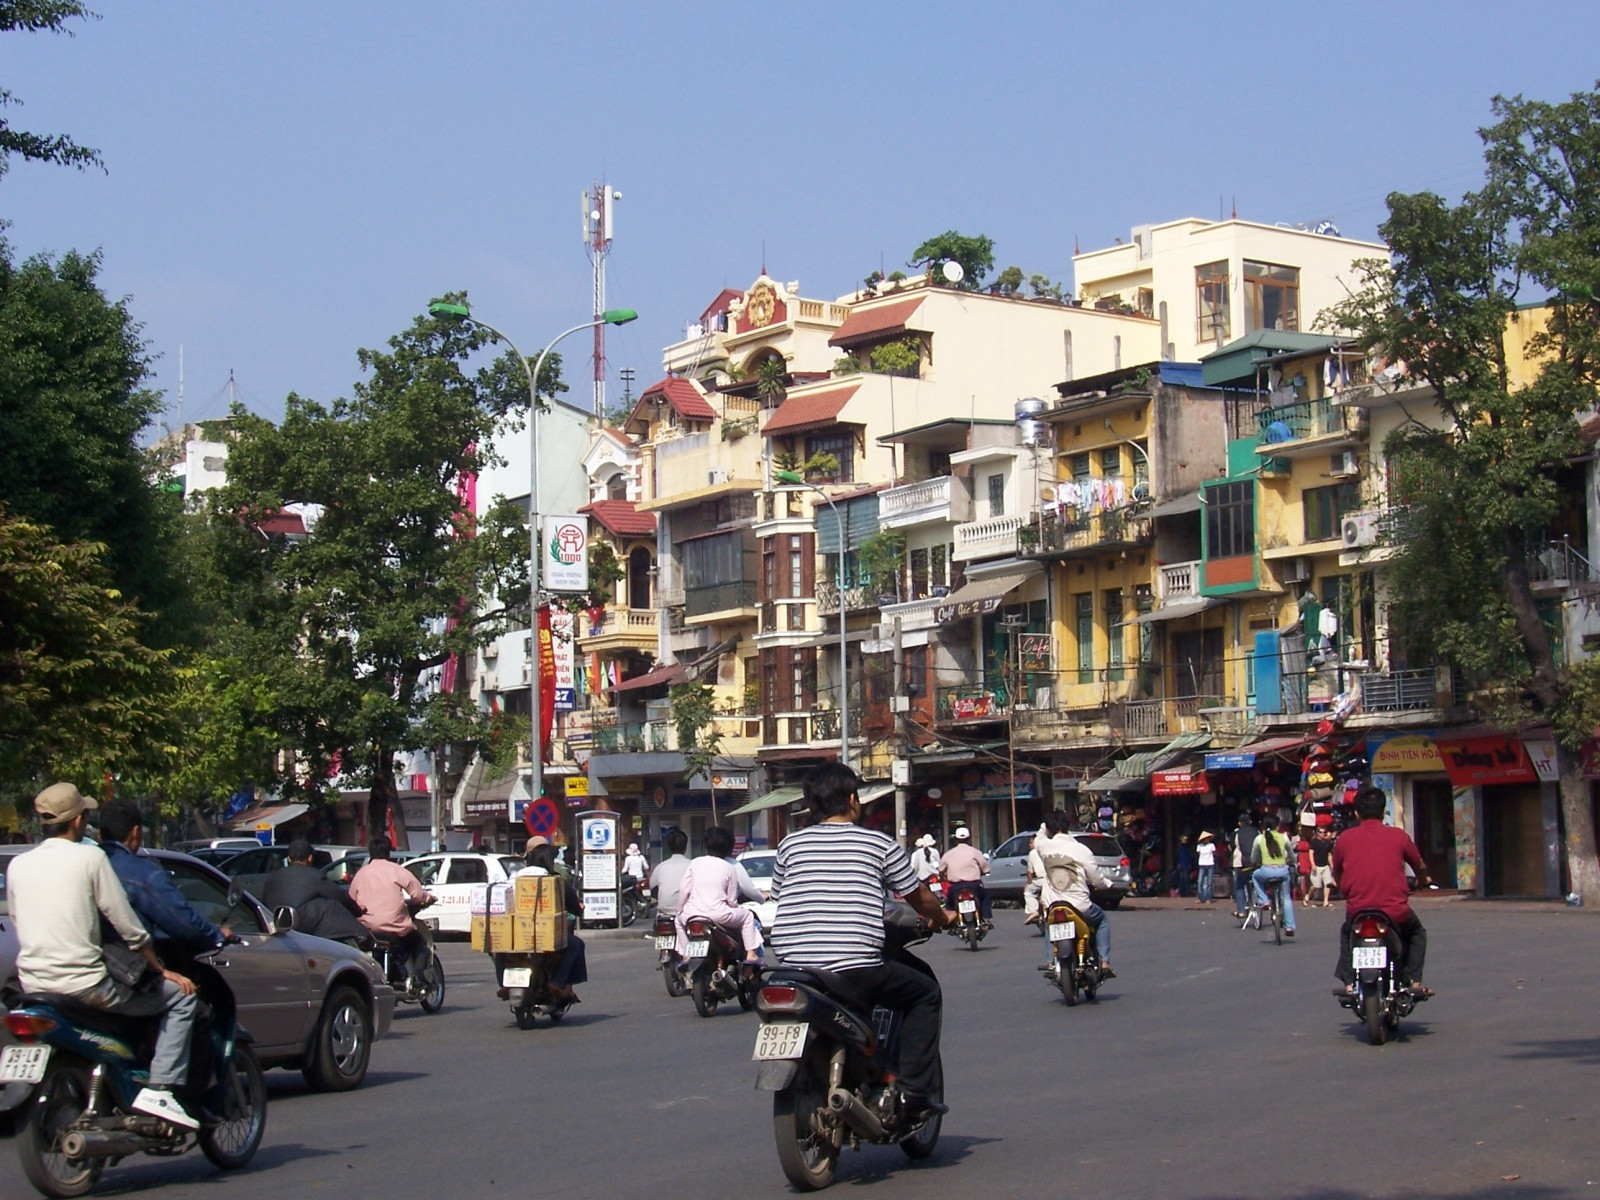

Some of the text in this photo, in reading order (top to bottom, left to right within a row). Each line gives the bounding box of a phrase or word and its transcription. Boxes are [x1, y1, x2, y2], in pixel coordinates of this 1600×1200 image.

[560, 553, 582, 562] 1000
[1535, 760, 1552, 772] HT
[763, 1026, 801, 1040] 99-F8
[760, 1041, 797, 1056] 0207
